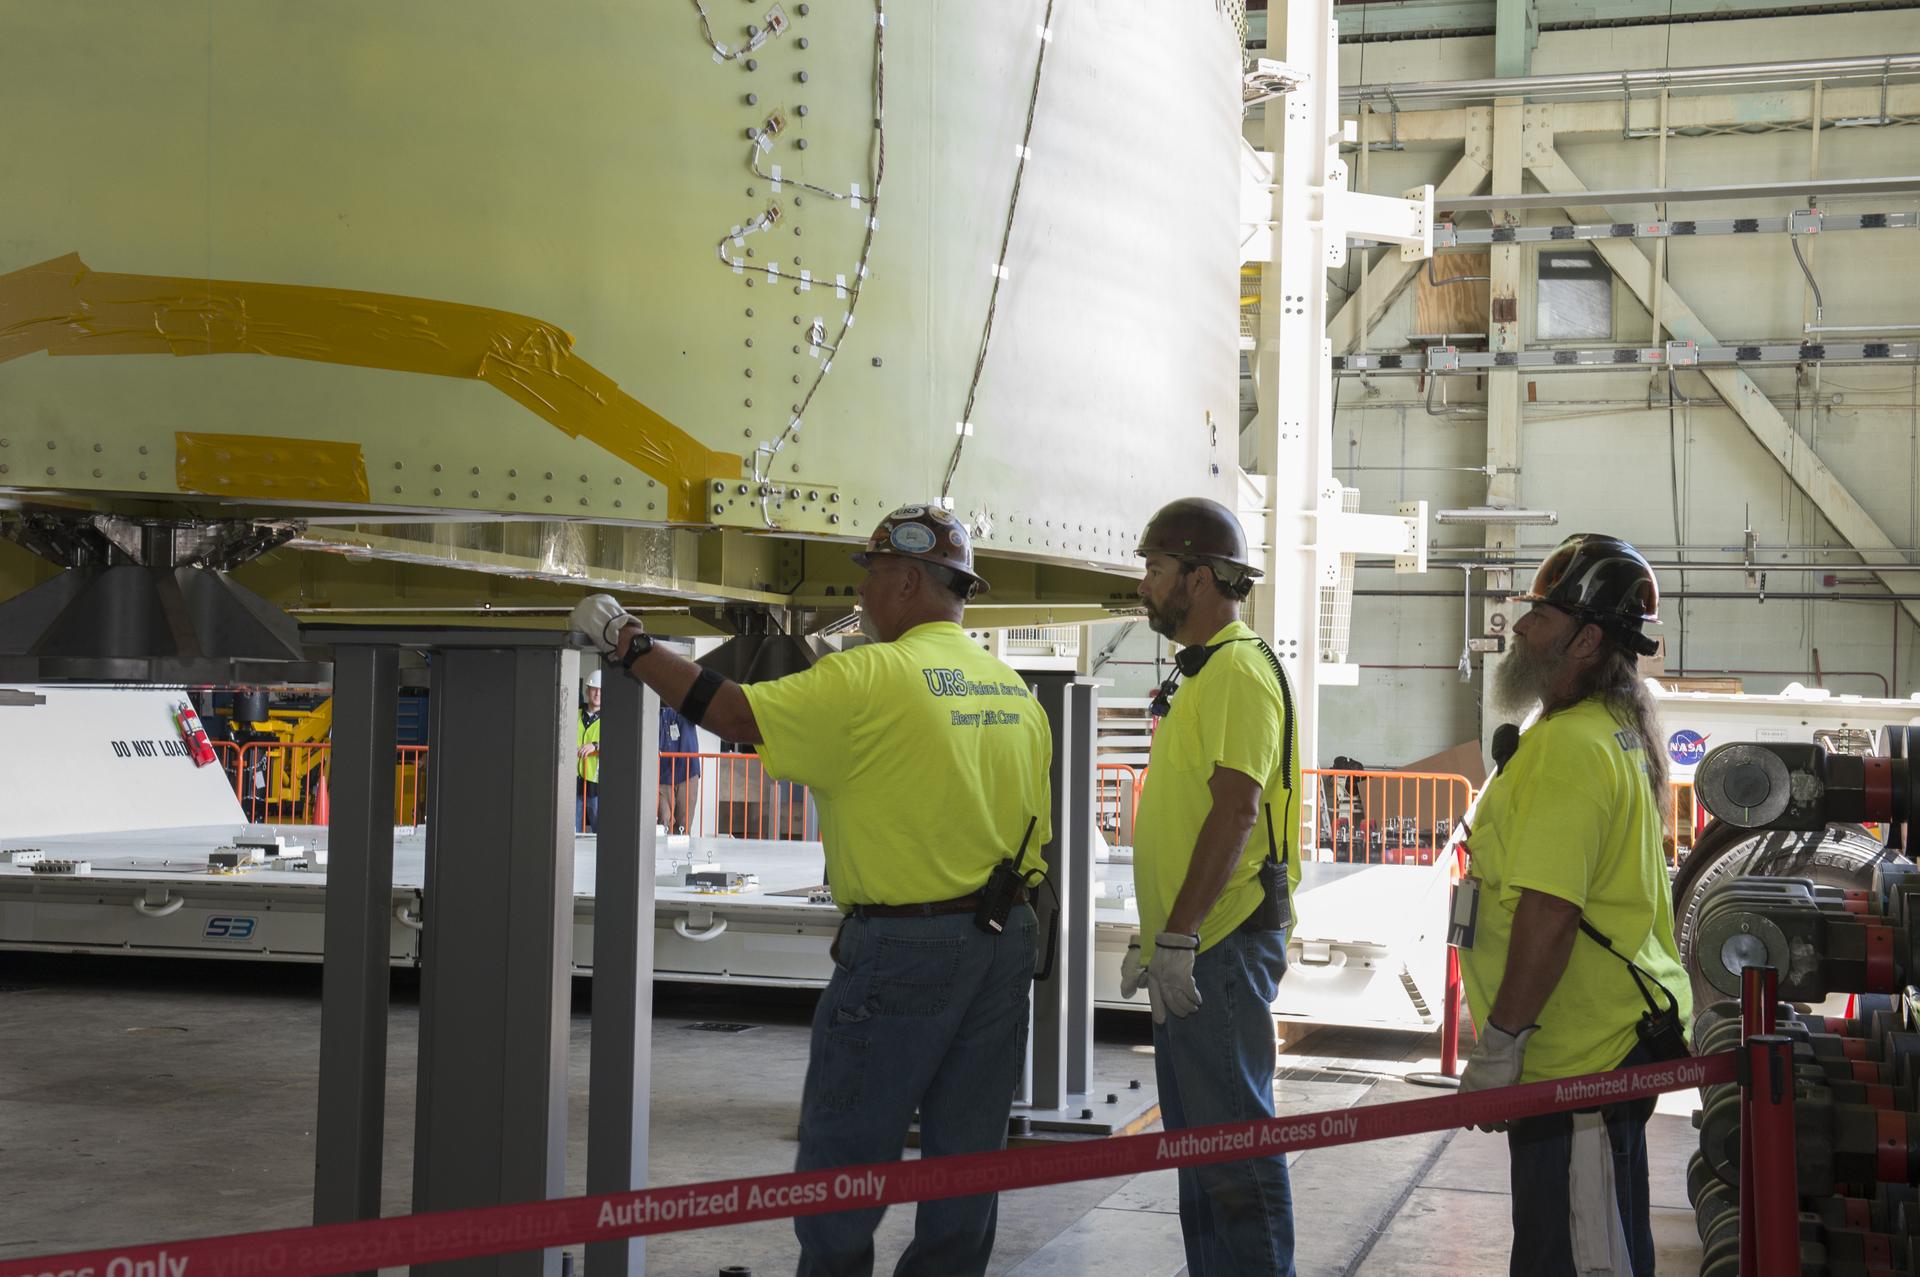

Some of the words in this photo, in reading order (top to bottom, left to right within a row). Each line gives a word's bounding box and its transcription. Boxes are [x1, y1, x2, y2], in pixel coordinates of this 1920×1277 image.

[1490, 613, 1506, 634] 9
[922, 668, 968, 696] URS
[967, 681, 1001, 696] Federal
[950, 710, 980, 728] Heavy
[980, 709, 999, 726] Lift
[998, 709, 1020, 725] Crew
[111, 741, 131, 757] DO
[132, 740, 158, 757] NOT
[160, 740, 190, 757] LOAD
[1669, 742, 1705, 753] NASA
[1555, 1073, 1627, 1103] Authorized
[1631, 1072, 1674, 1091] Access
[1677, 1062, 1706, 1084] Only
[1156, 1125, 1254, 1160] Authorized
[1259, 1124, 1316, 1146] Access
[1320, 1113, 1358, 1138] Only
[597, 1185, 738, 1228] Authorized
[746, 1182, 828, 1210] Access
[833, 1171, 886, 1201] Only
[106, 1251, 188, 1277] Only
